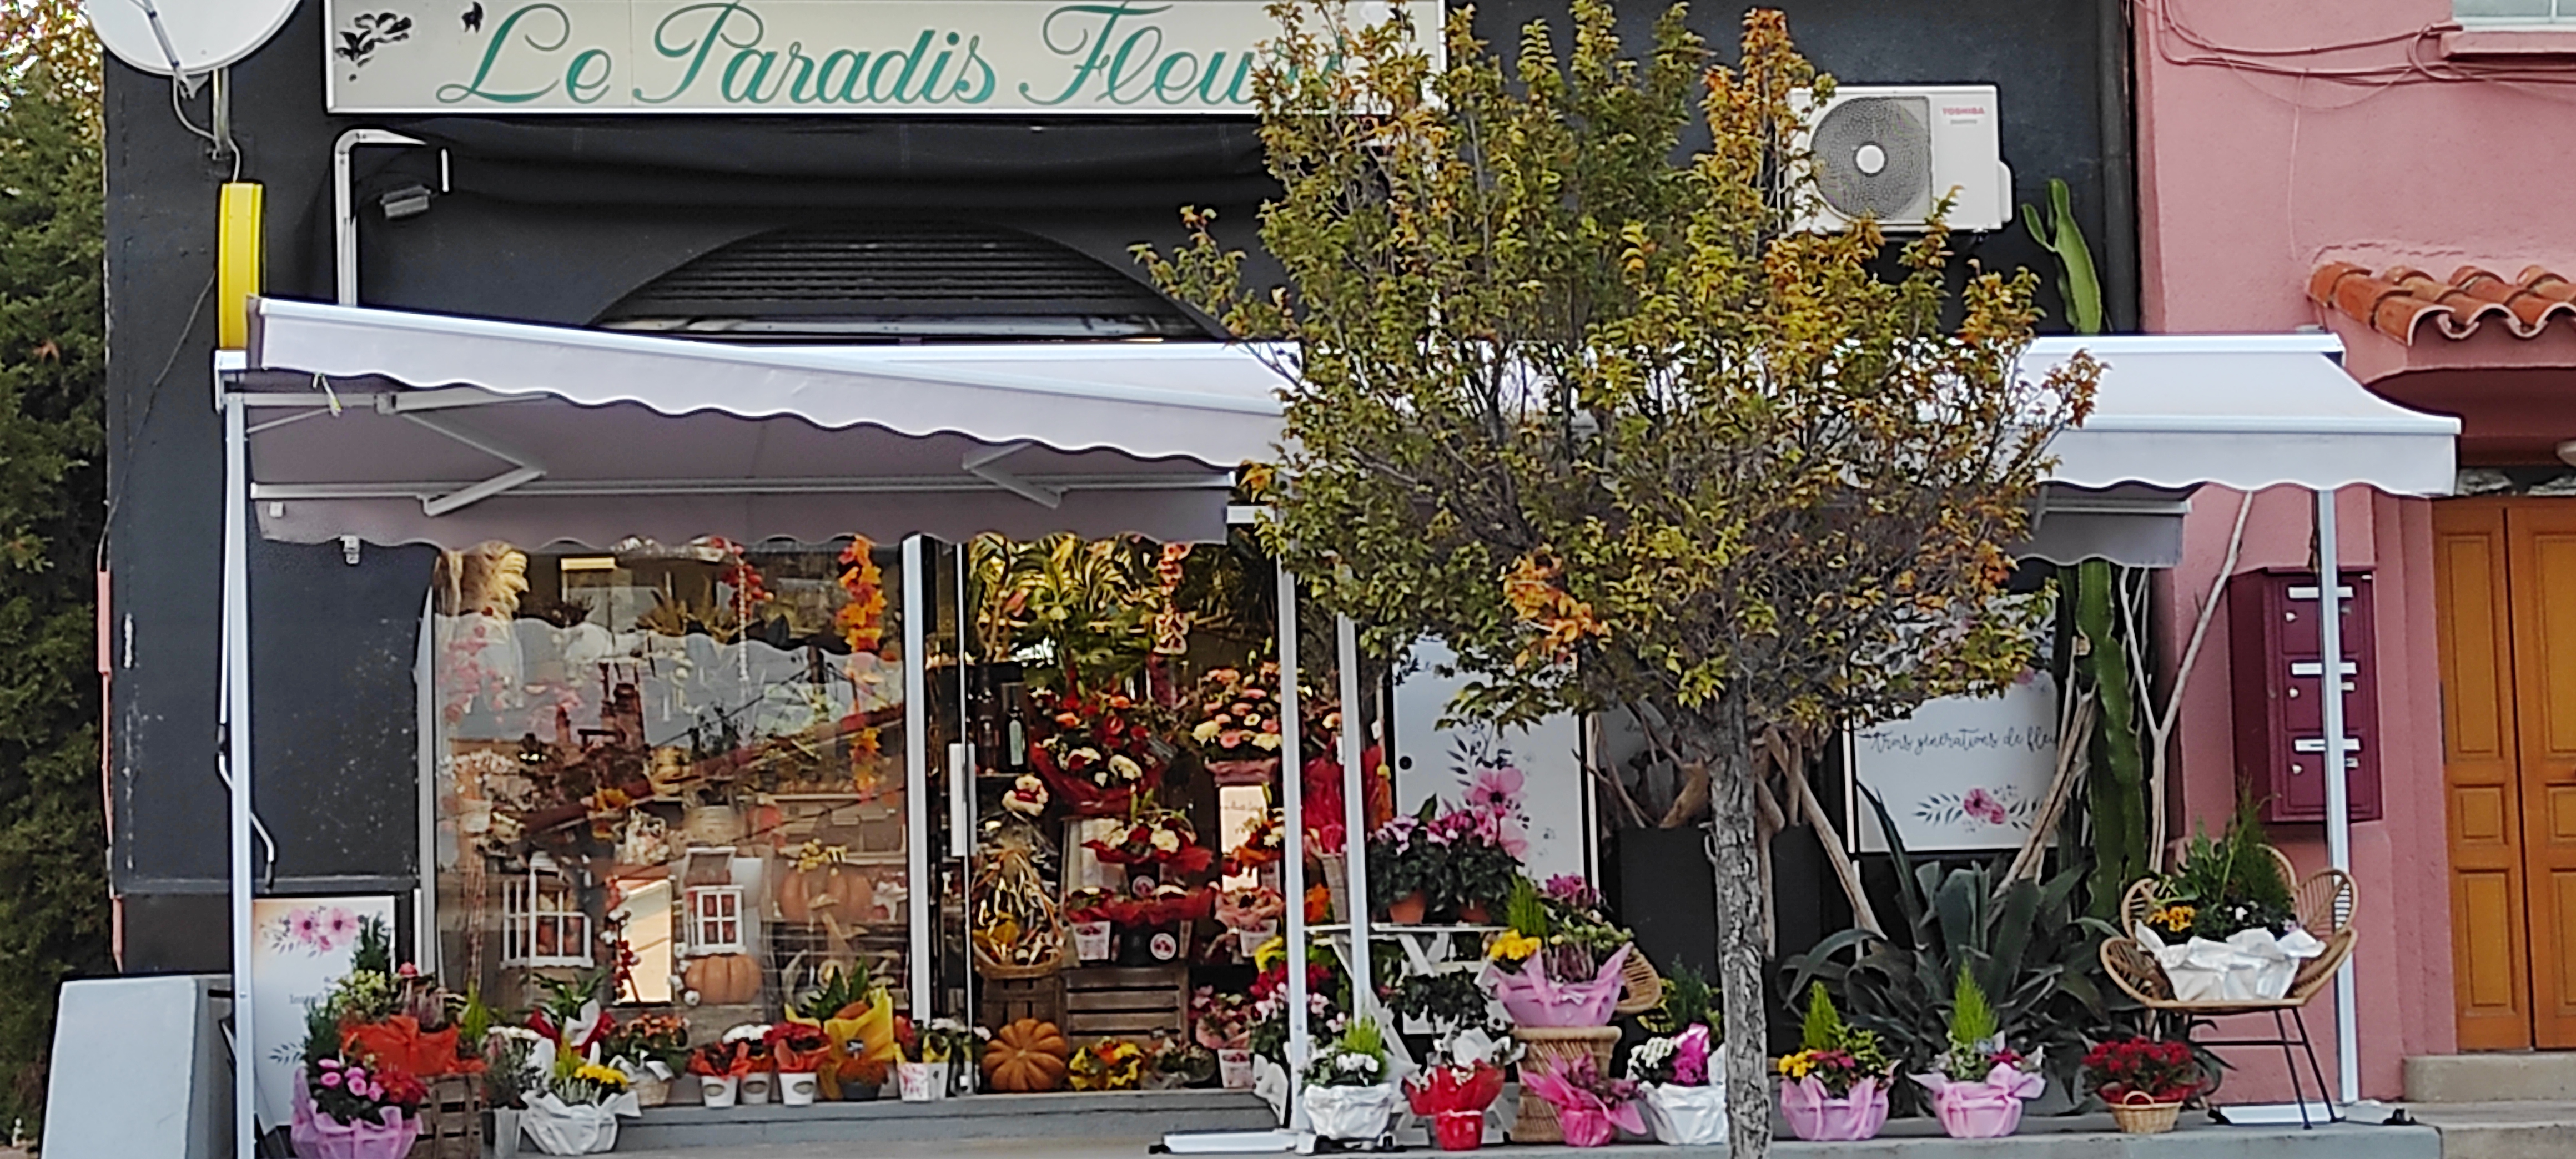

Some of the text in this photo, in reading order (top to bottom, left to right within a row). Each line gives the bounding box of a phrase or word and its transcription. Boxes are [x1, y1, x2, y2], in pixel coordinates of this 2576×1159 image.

[436, 0, 1354, 105] Le Paradis Fleu
[2003, 725, 2022, 747] de
